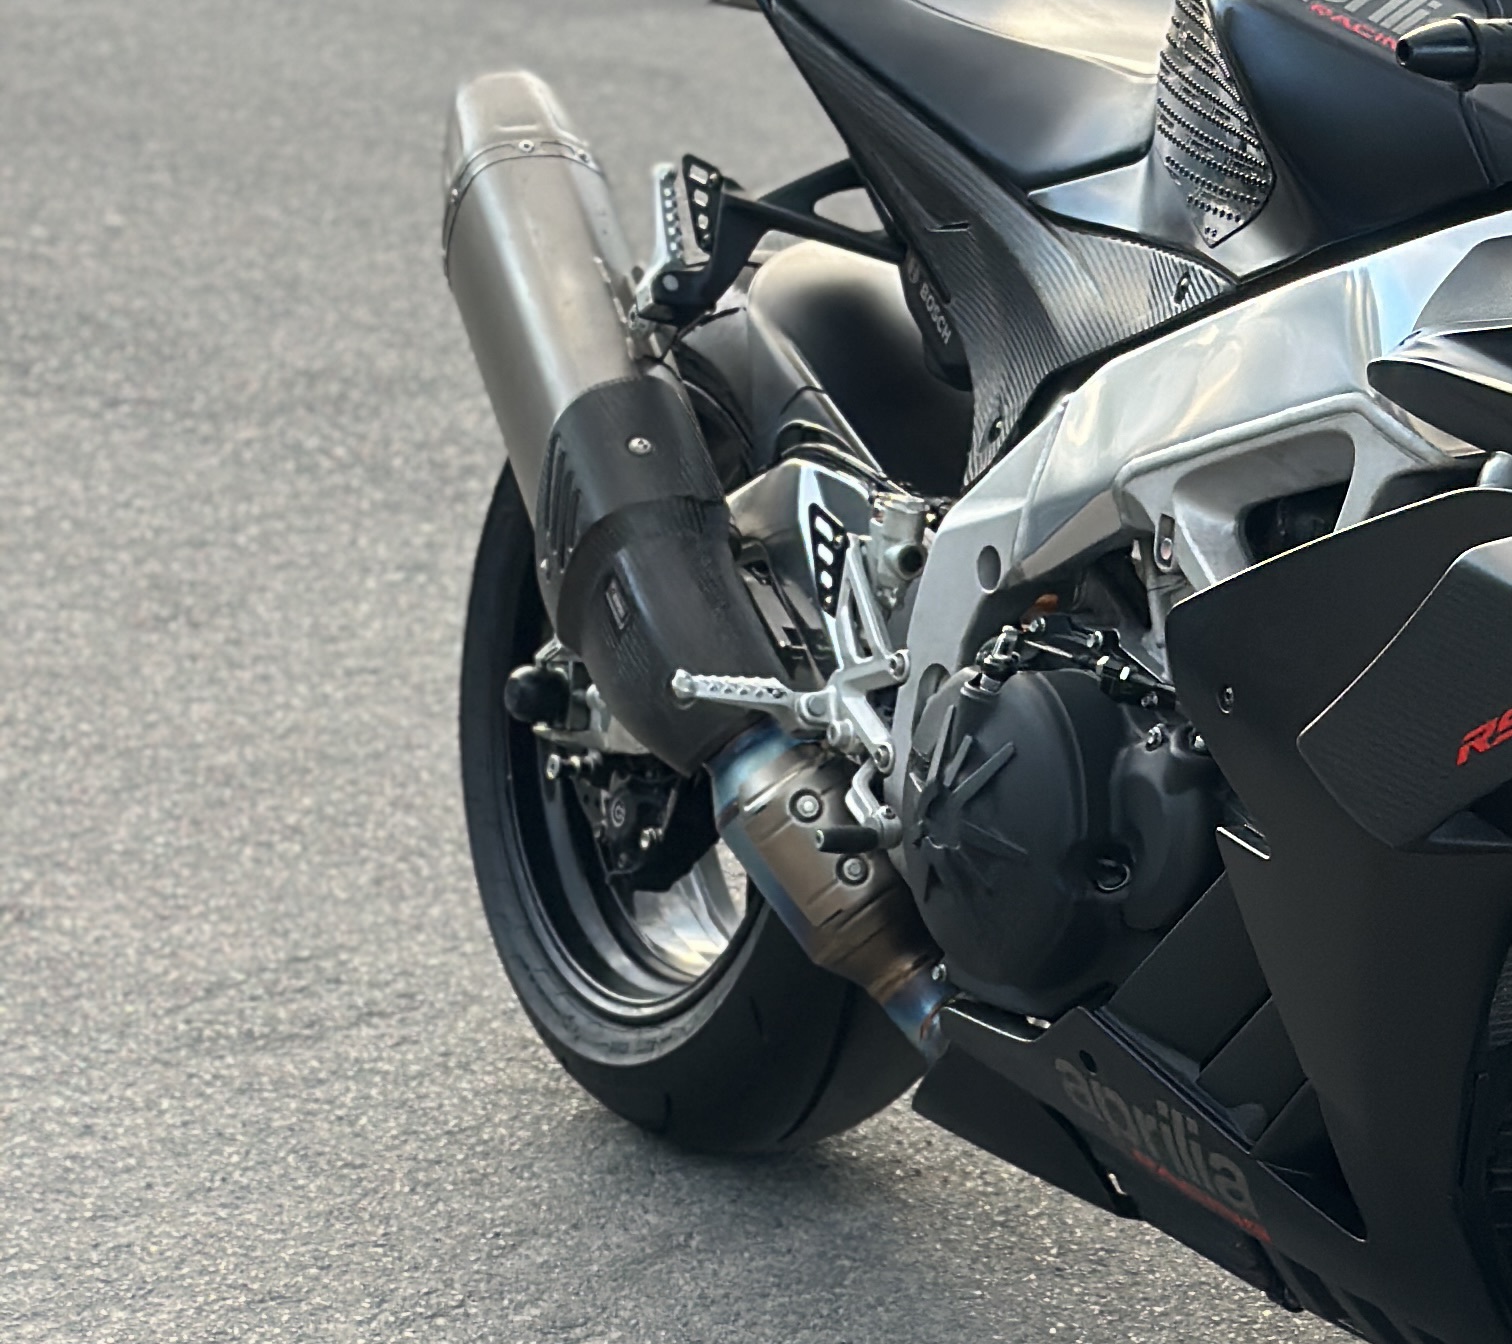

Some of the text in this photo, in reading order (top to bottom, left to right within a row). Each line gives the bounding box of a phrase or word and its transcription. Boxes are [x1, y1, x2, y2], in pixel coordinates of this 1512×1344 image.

[1310, 3, 1397, 52] RACIN
[920, 281, 952, 345] BOSCH
[1054, 1057, 1260, 1219] aprilia
